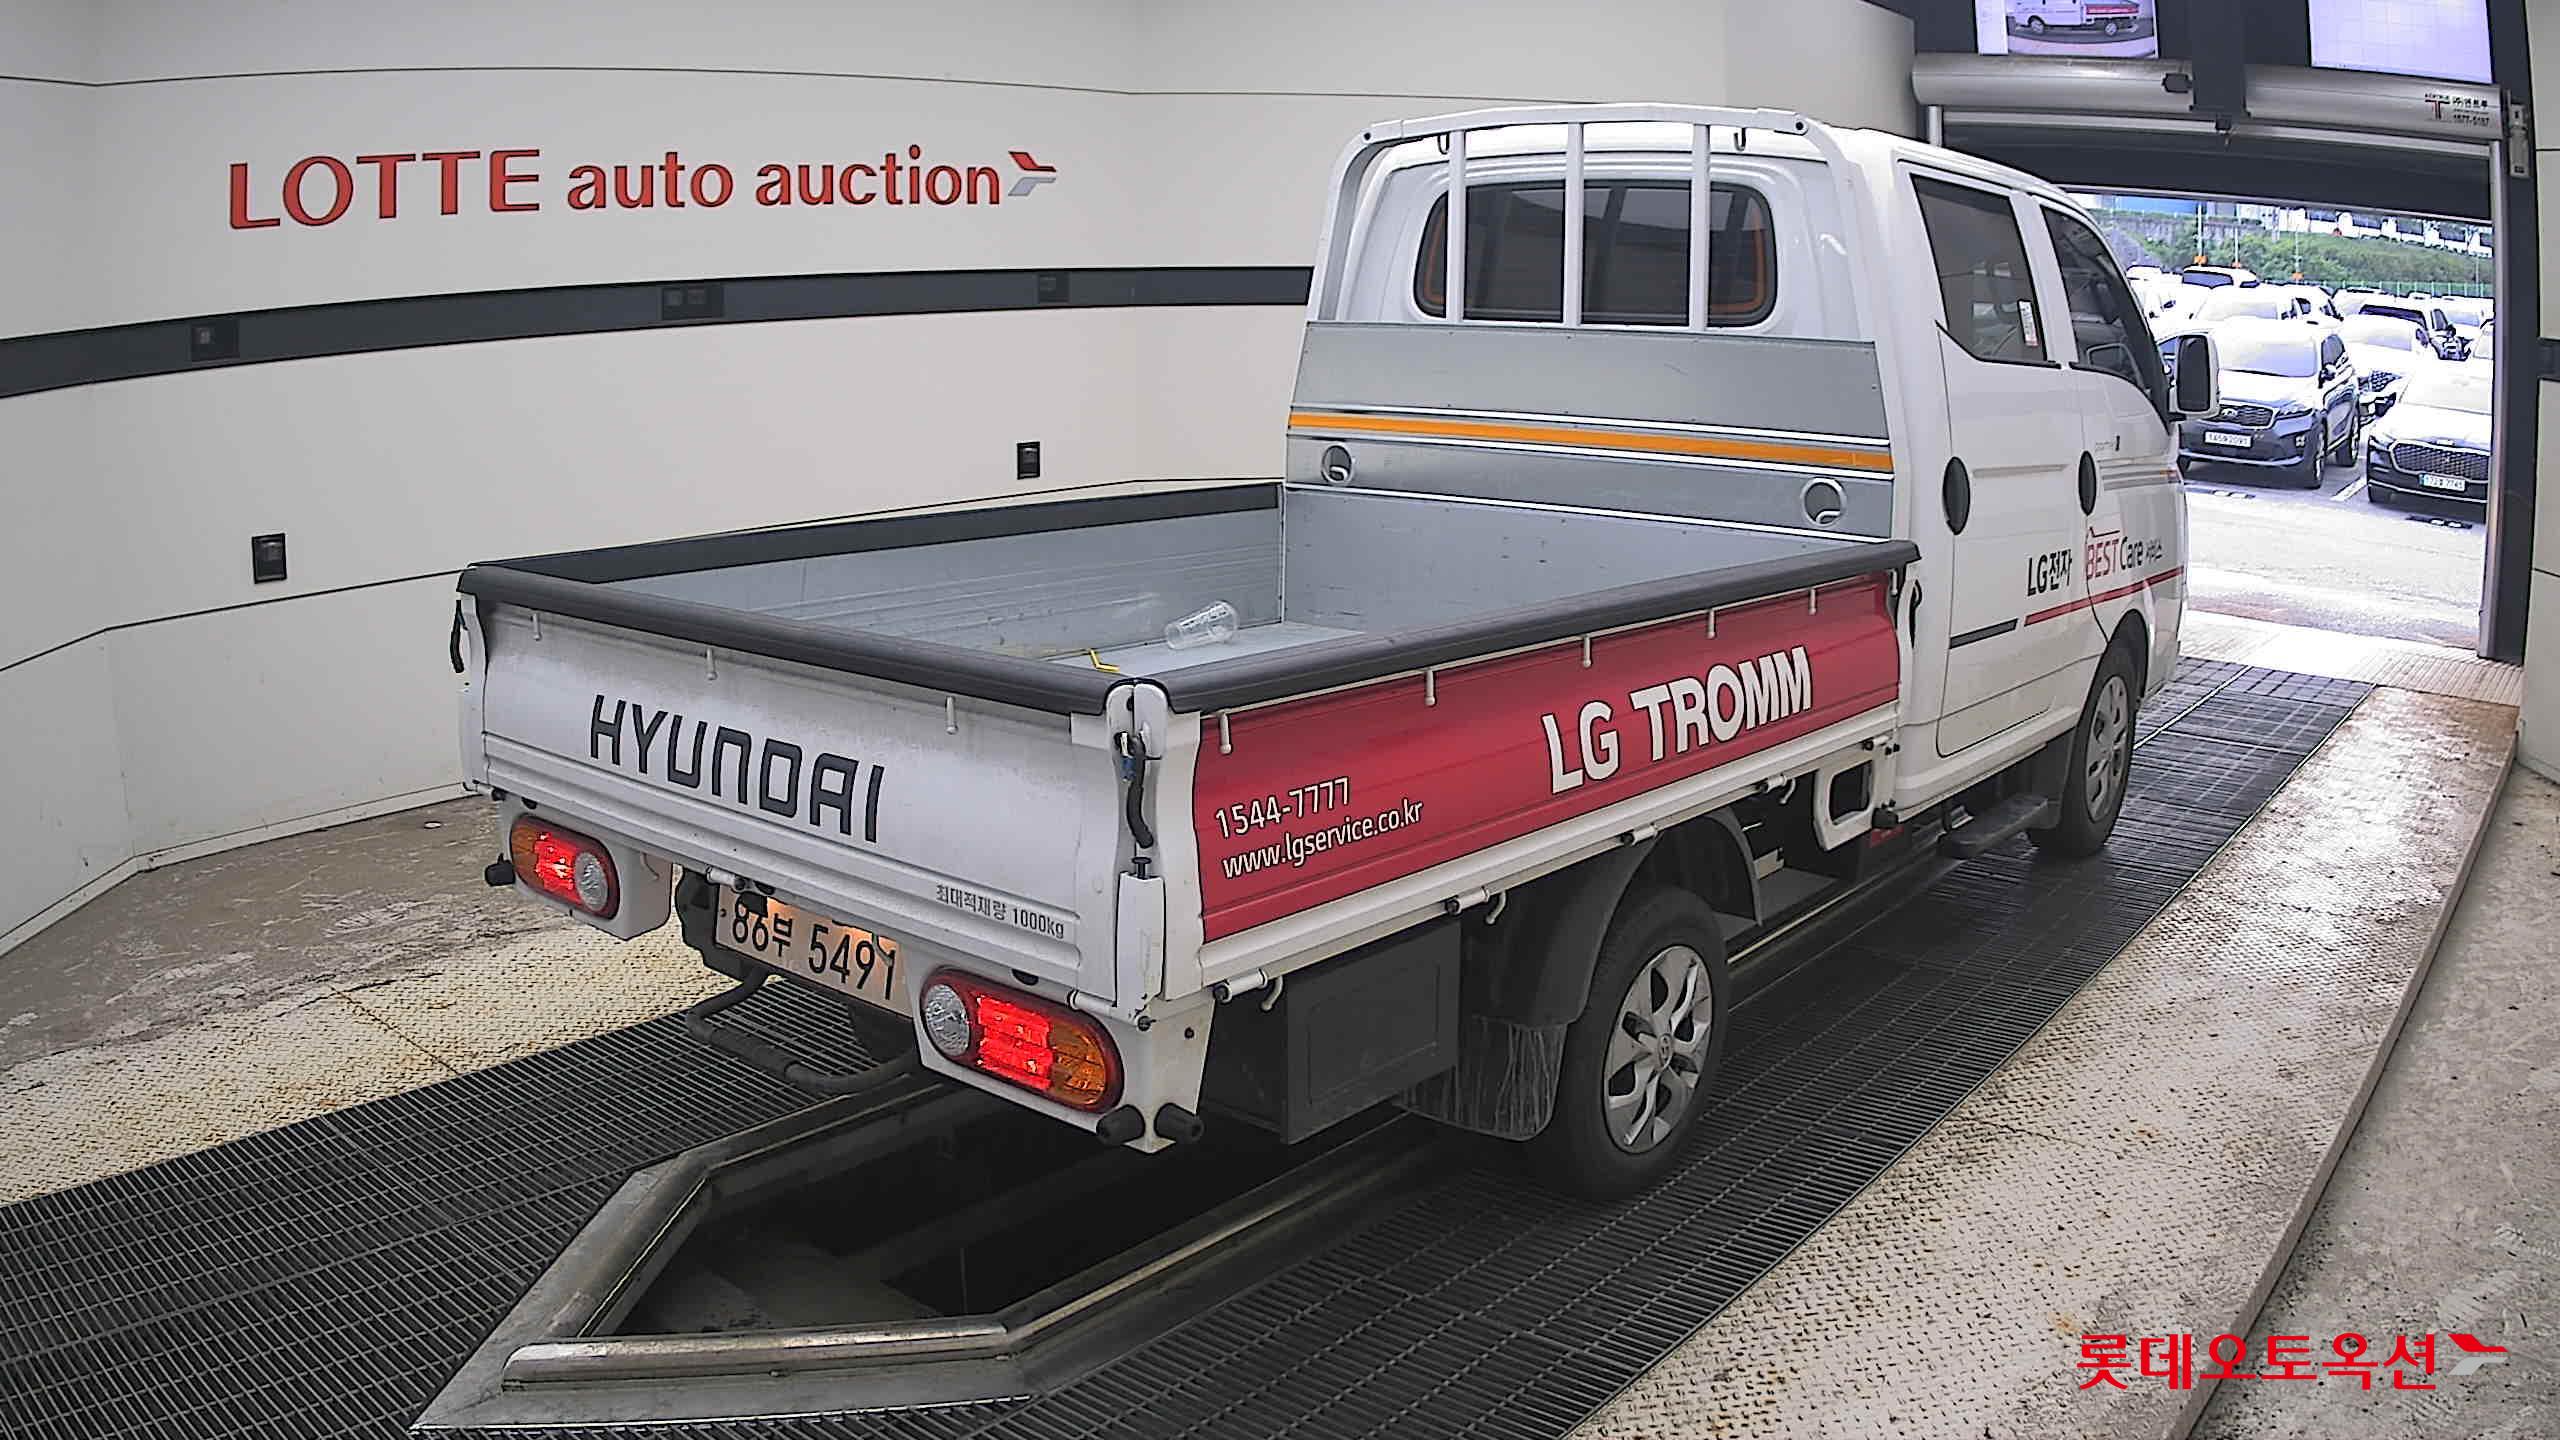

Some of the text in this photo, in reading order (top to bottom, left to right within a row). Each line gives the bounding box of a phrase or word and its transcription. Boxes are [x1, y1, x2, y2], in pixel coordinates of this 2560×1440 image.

[229, 144, 1001, 230] LOTTE auto auction
[2027, 548, 2073, 597] LG전자
[1539, 645, 1814, 795] LG TROMM
[590, 694, 885, 844] HYUNDAI
[1215, 776, 1350, 839] 1544-7777
[1222, 798, 1424, 879] www.lgservice.co.kr
[732, 892, 896, 1001] 86부 5491
[936, 884, 1064, 940] 최대적재량 1000kg
